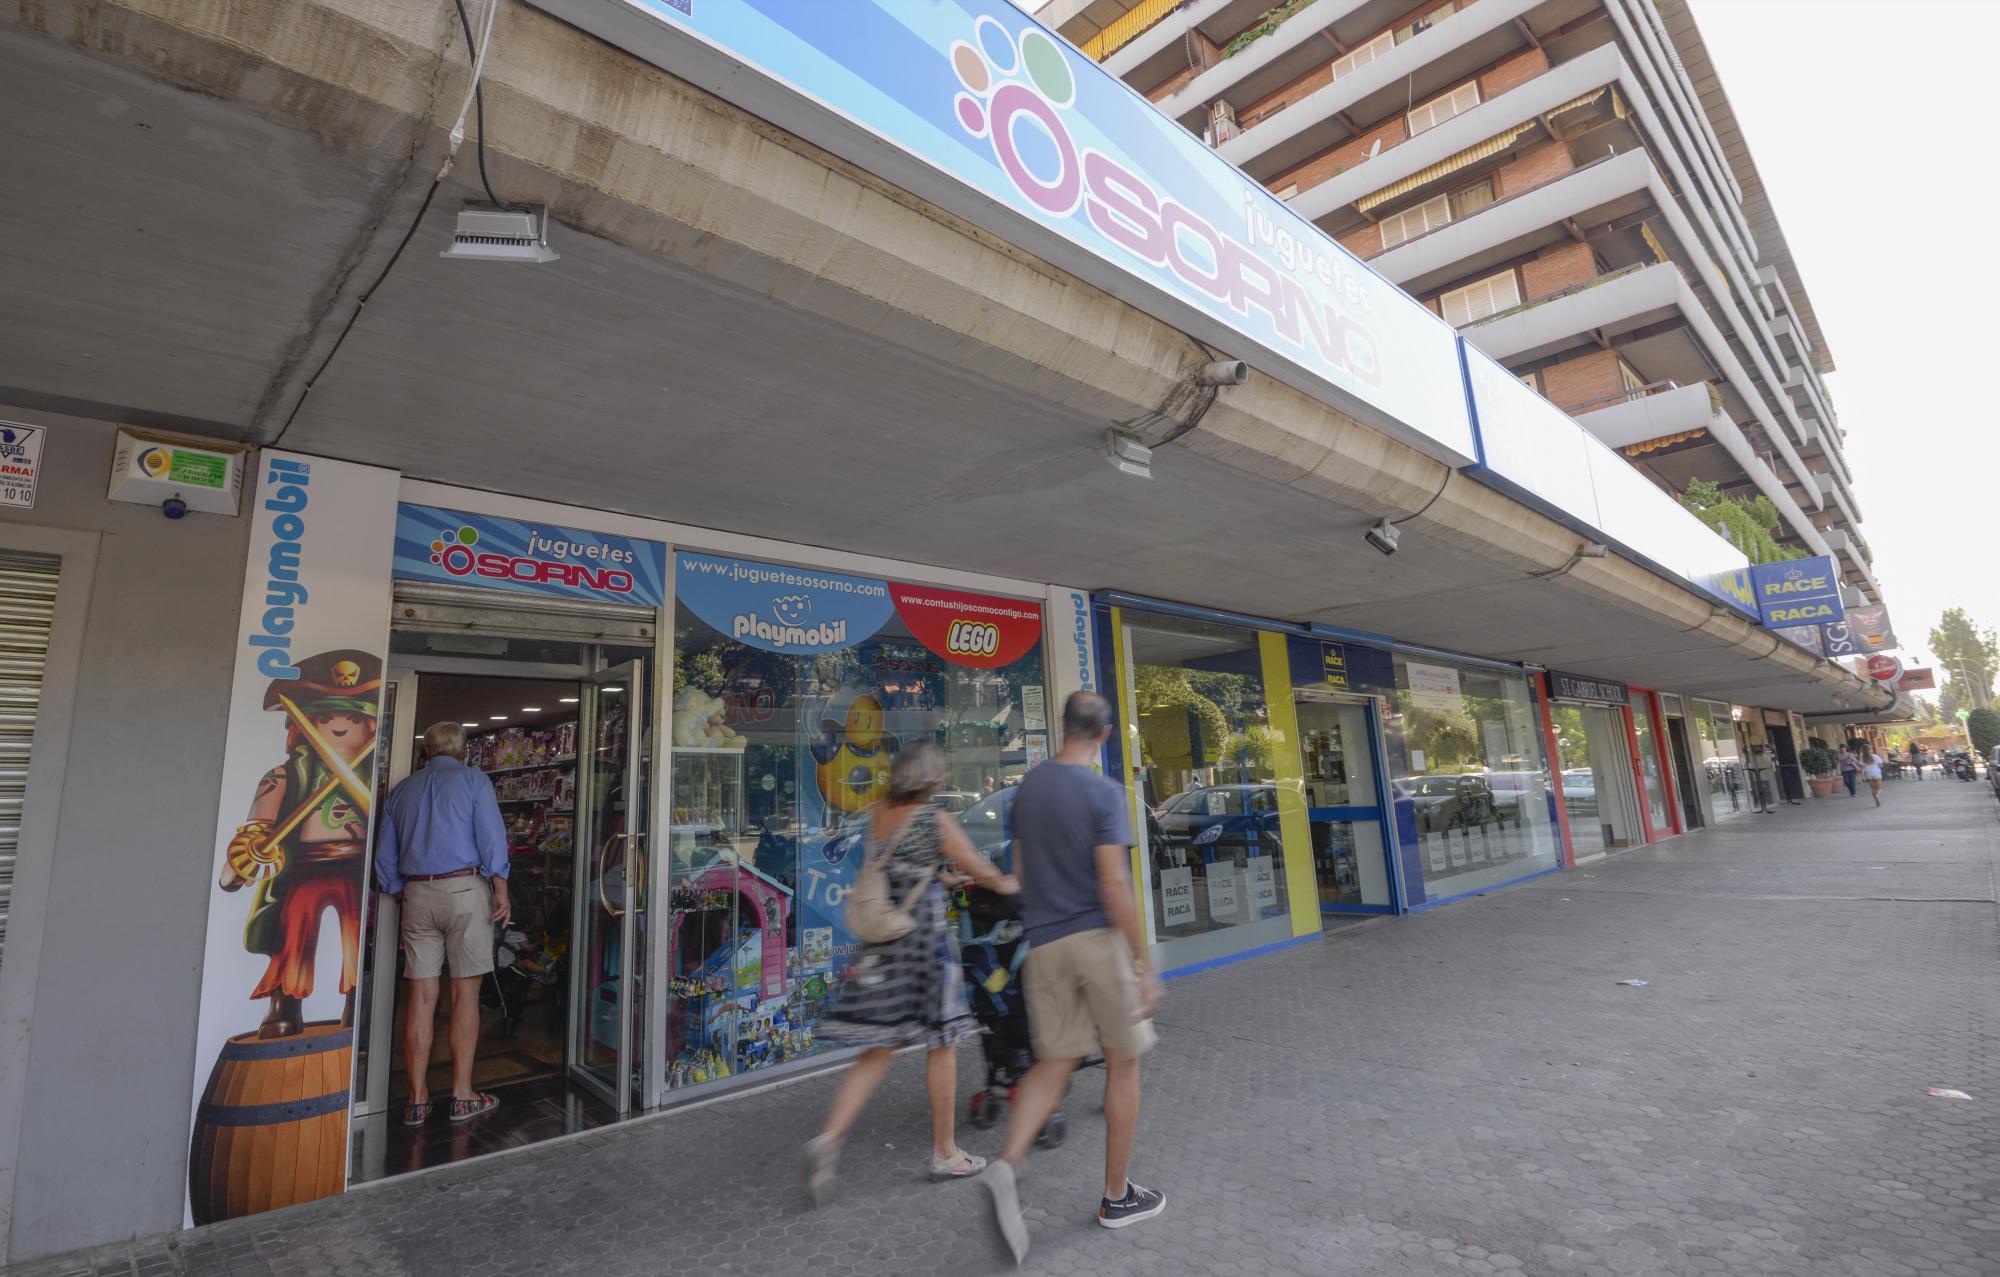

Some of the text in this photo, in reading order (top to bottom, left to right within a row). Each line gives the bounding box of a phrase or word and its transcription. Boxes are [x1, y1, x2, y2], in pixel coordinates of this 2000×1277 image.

[990, 81, 1383, 390] OSORNO
[1244, 189, 1373, 313] juguetes
[5, 488, 32, 502] 10 10
[527, 529, 633, 564] juguetes
[249, 457, 309, 680] playmobil
[441, 544, 634, 593] OSORNO
[683, 559, 885, 598] www.juguetesosorno.com
[1764, 576, 1828, 595] RACE
[900, 594, 1040, 621] www.contushijoscomocontigo.com
[1770, 604, 1834, 622] RACA
[733, 613, 846, 647] playmobil
[948, 620, 998, 655] LEGO
[1071, 593, 1094, 692] playmob
[1826, 620, 1853, 653] SG
[1325, 655, 1344, 666] RACE
[1327, 674, 1346, 684] RACA
[1571, 680, 1599, 699] GABRIEL
[1599, 684, 1624, 701] SCHOOL
[1165, 885, 1190, 897] RACE
[1167, 904, 1191, 917] RACA
